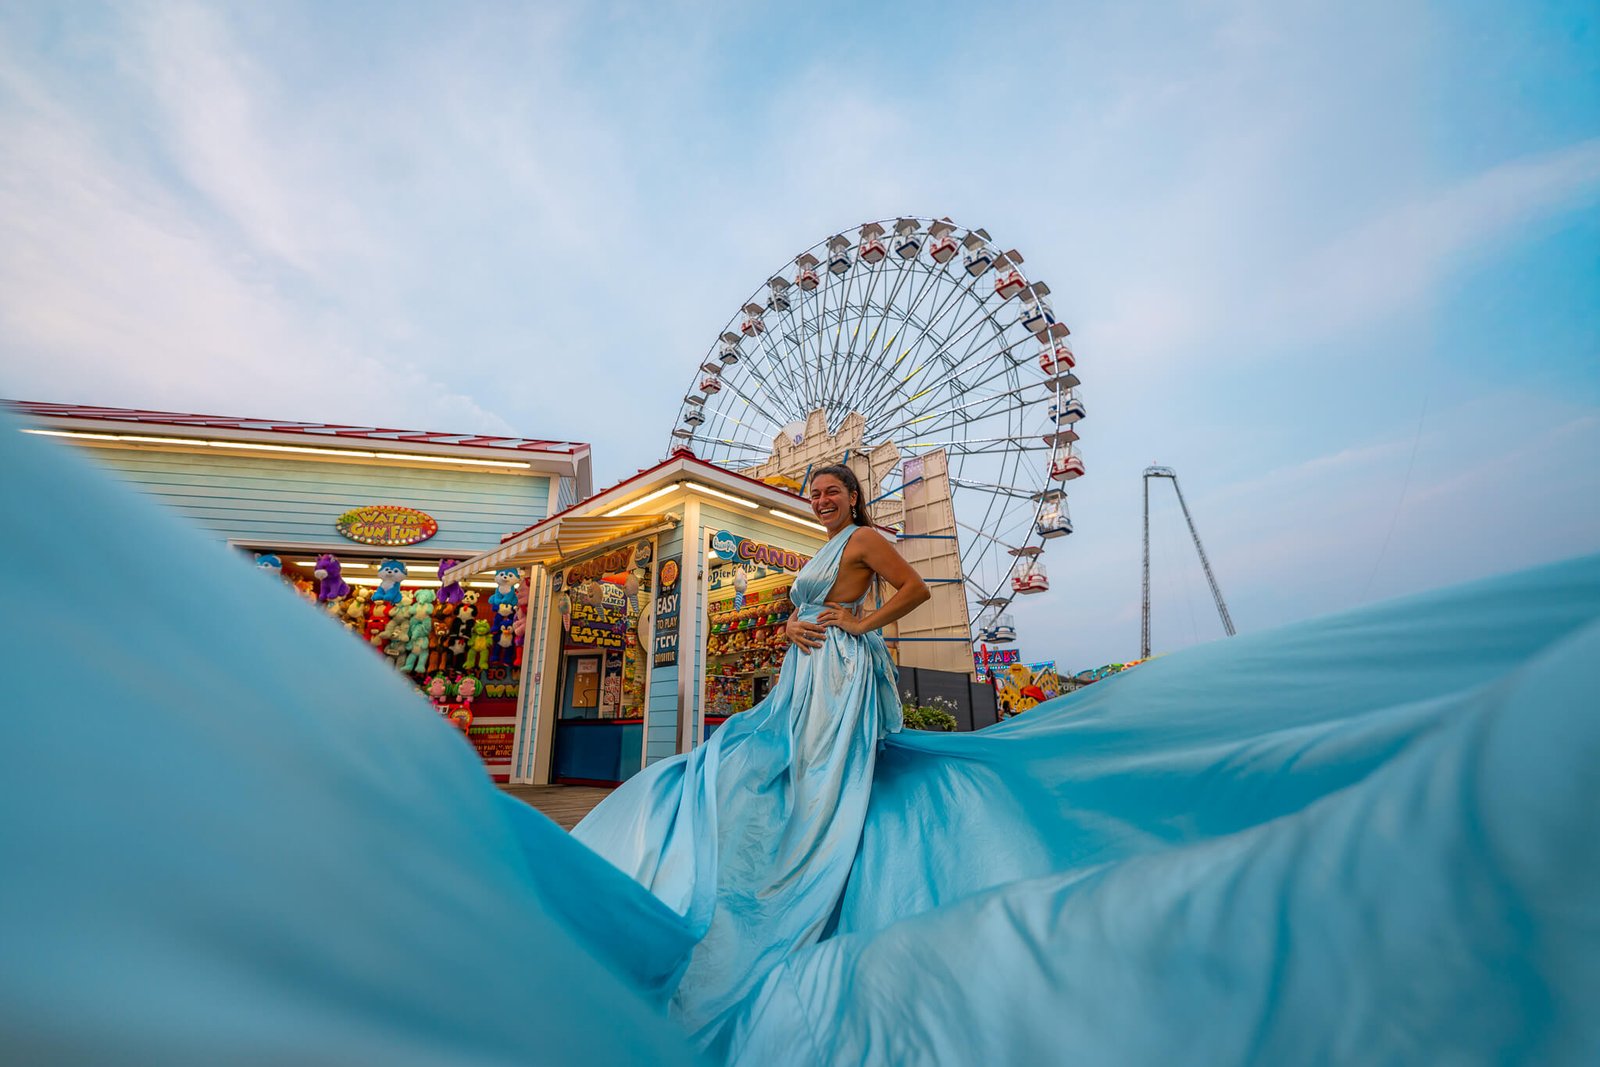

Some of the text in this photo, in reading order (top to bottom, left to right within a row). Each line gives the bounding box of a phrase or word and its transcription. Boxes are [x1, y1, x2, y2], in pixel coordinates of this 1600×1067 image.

[359, 511, 418, 525] WATER
[350, 522, 421, 540] GUN FUN
[739, 539, 812, 571] CANDY
[656, 593, 679, 616] EASY
[664, 616, 678, 629] PLAY
[570, 625, 612, 638] EASY
[570, 633, 622, 648] WIN
